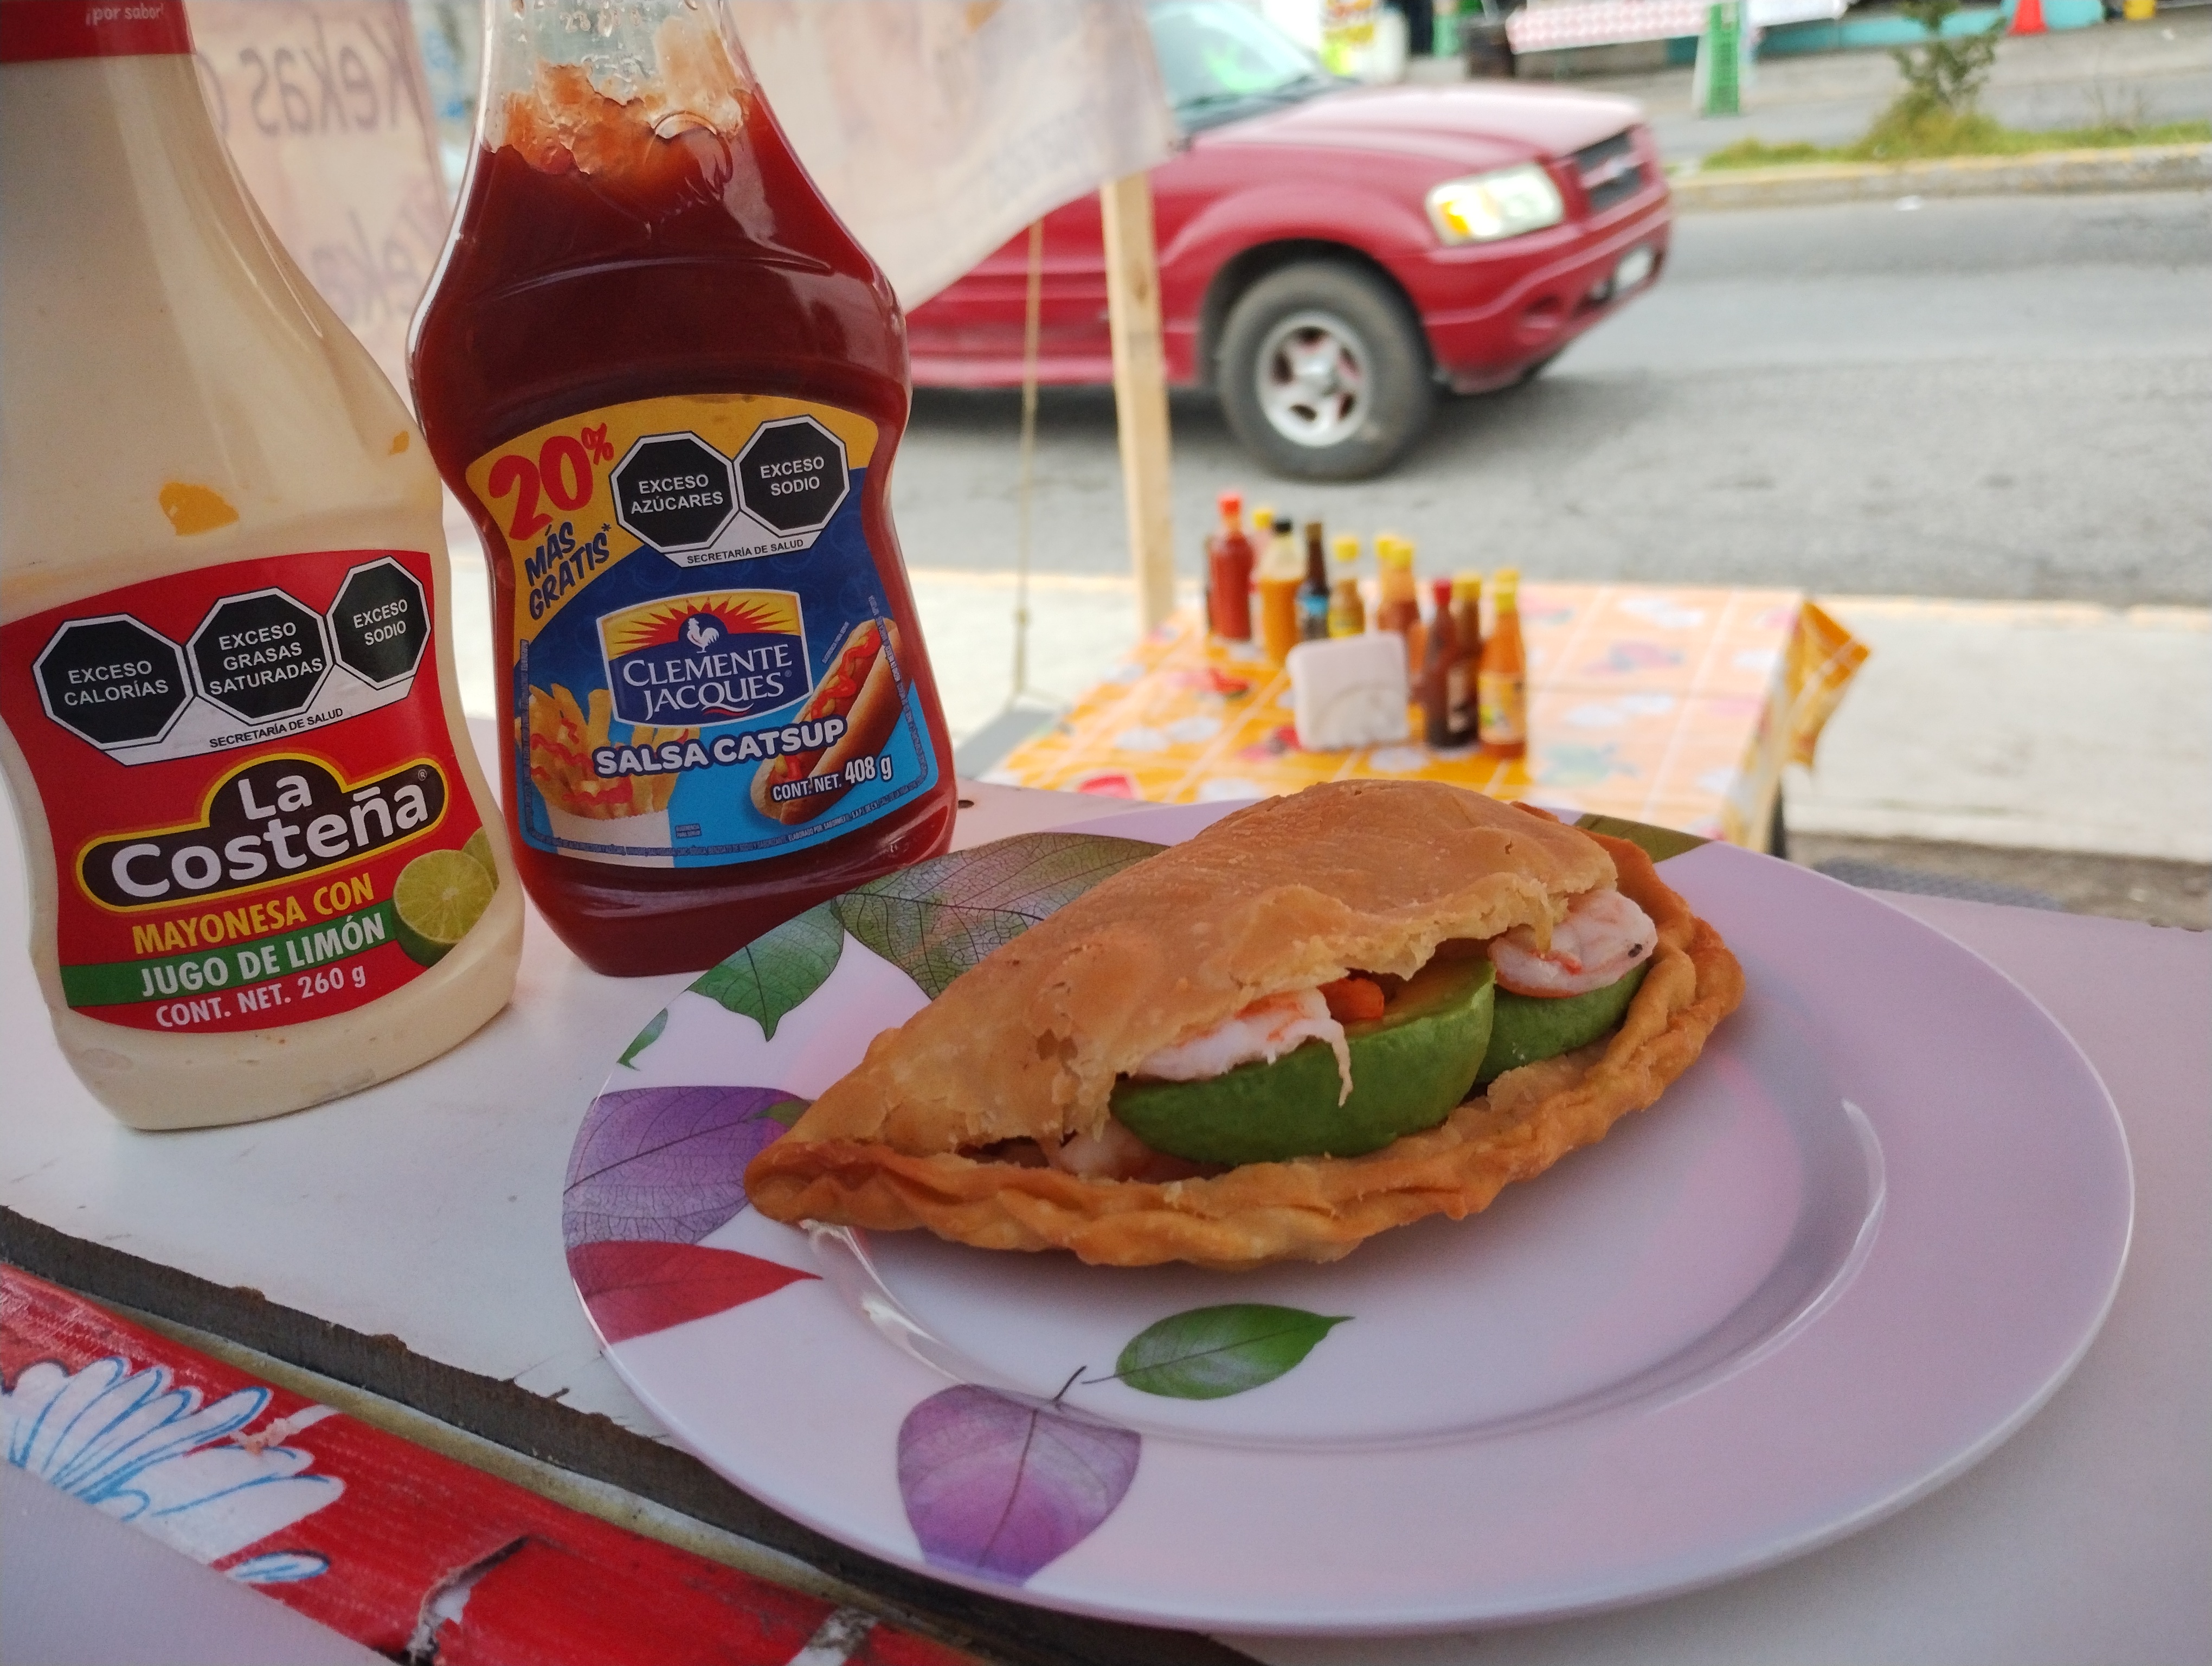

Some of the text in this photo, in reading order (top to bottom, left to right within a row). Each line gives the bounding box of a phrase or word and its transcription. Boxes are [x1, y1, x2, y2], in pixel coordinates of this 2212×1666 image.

[488, 422, 614, 541] 20%
[639, 474, 709, 495] EXCESO
[760, 456, 825, 479] EXCESO
[770, 476, 821, 496] SODIO
[631, 490, 724, 514] AZÚCARES
[525, 521, 576, 587] MÁS
[686, 539, 804, 565] SECRETARÍA DE SALUD
[353, 599, 409, 629] EXCESO
[364, 620, 407, 647] SODIO
[218, 621, 297, 651] EXCESO
[67, 660, 152, 685] EXCESO
[222, 642, 303, 671] GRASAS
[623, 644, 793, 687] CLEMENTE
[63, 679, 169, 707] CALORÍAS
[209, 658, 324, 696] SATURADAS
[643, 671, 785, 721] JACQUES
[209, 707, 344, 748] SECRETARÍA DE SALUD
[597, 718, 844, 774] SALSA CATSUP
[238, 773, 313, 821] La
[773, 756, 892, 801] CONT. NET. 408 g
[111, 781, 430, 899] Costeña
[132, 873, 375, 954] MAYONESA CON
[142, 913, 385, 997] JUGO DE LIMÓN
[156, 965, 366, 1028] CONT. NET. 260 g
